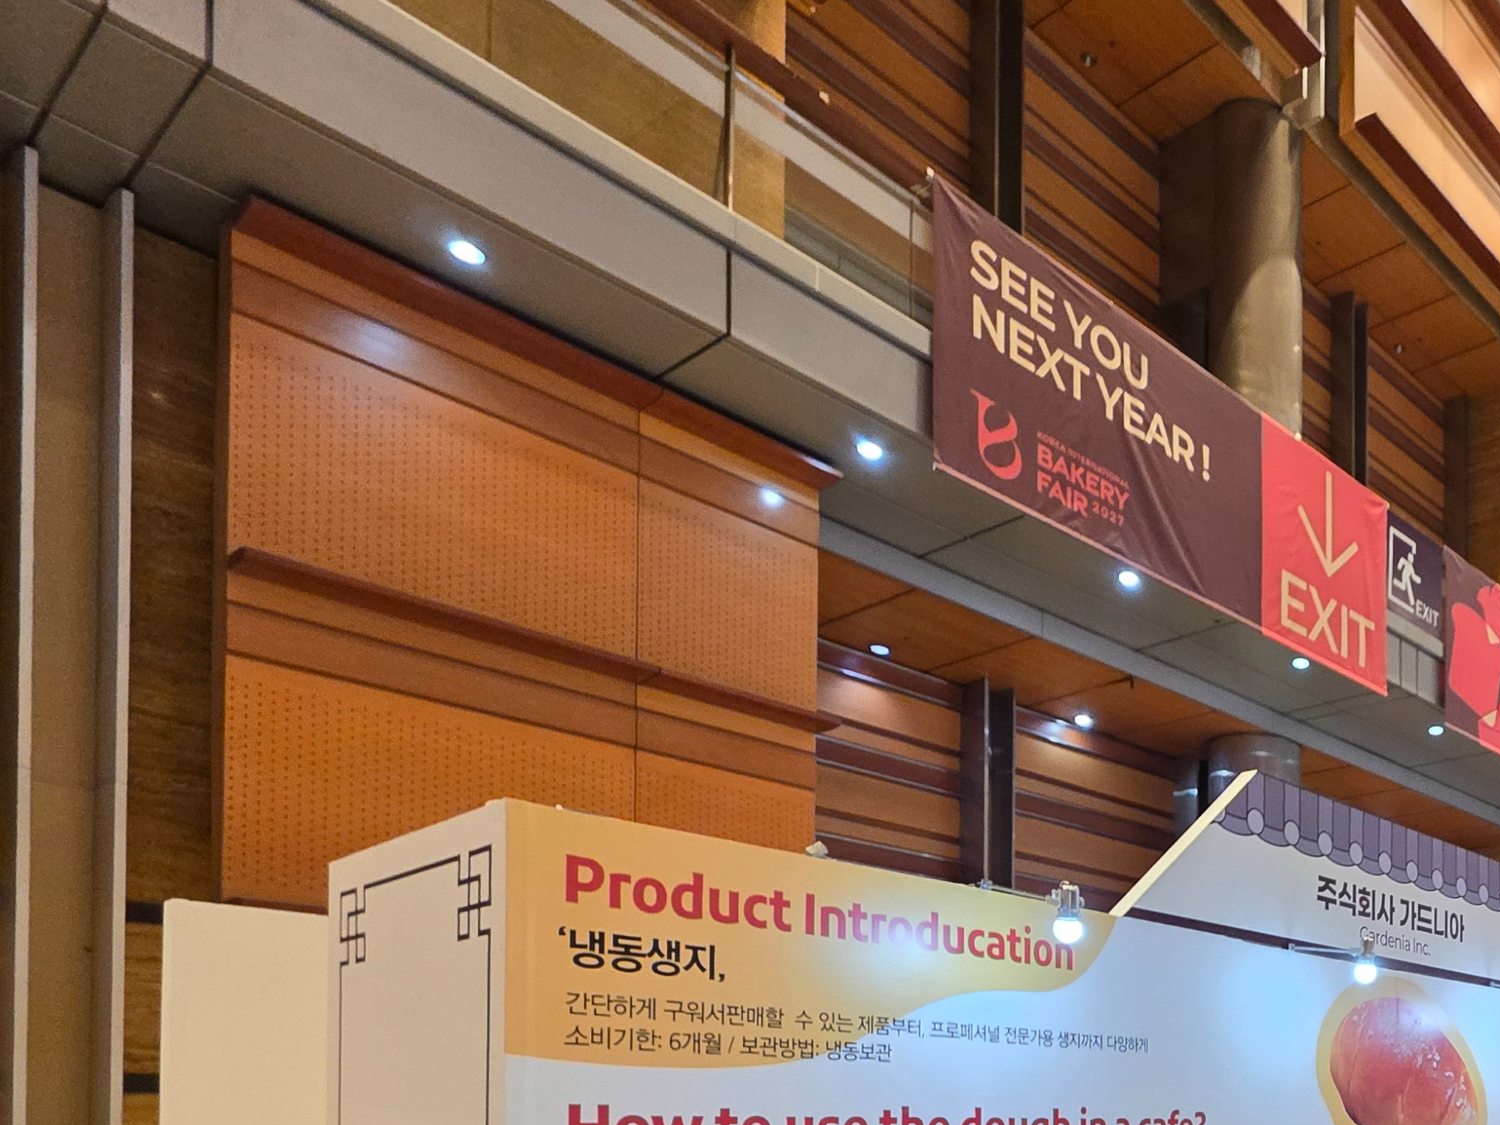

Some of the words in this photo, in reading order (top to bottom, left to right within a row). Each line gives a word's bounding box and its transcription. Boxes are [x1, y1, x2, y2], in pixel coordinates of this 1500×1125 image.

[970, 240, 1056, 332] SEE
[1063, 299, 1149, 390] YOU
[973, 294, 1091, 401] NEXT
[1037, 443, 1130, 511] BAKERY
[1037, 470, 1088, 517] FAIR
[1280, 568, 1376, 669] EXIT
[1415, 599, 1440, 627] EXIT
[565, 853, 792, 932] Product
[804, 892, 1075, 971] Introducation
[1316, 875, 1395, 925] 주식회사
[1399, 900, 1465, 943] 가드니아
[1359, 925, 1411, 952] Gardenia
[1413, 937, 1432, 956] Inc.
[564, 1025, 662, 1053] 소비기한:
[669, 1032, 722, 1055] 6개월
[739, 1036, 819, 1061] 보관방법:
[825, 1040, 893, 1063] 냉동보관
[565, 991, 657, 1021] 간단하게
[664, 998, 785, 1030] 구워서판매할
[794, 1010, 814, 1031] 수
[819, 1011, 854, 1035] 있는
[858, 1014, 925, 1039] 제품부터,
[930, 1020, 1001, 1043] 프로페셔널
[1004, 1025, 1055, 1048] 전문가용
[1057, 1030, 1104, 1051] 생지까지
[1106, 1035, 1150, 1054] 다양하게
